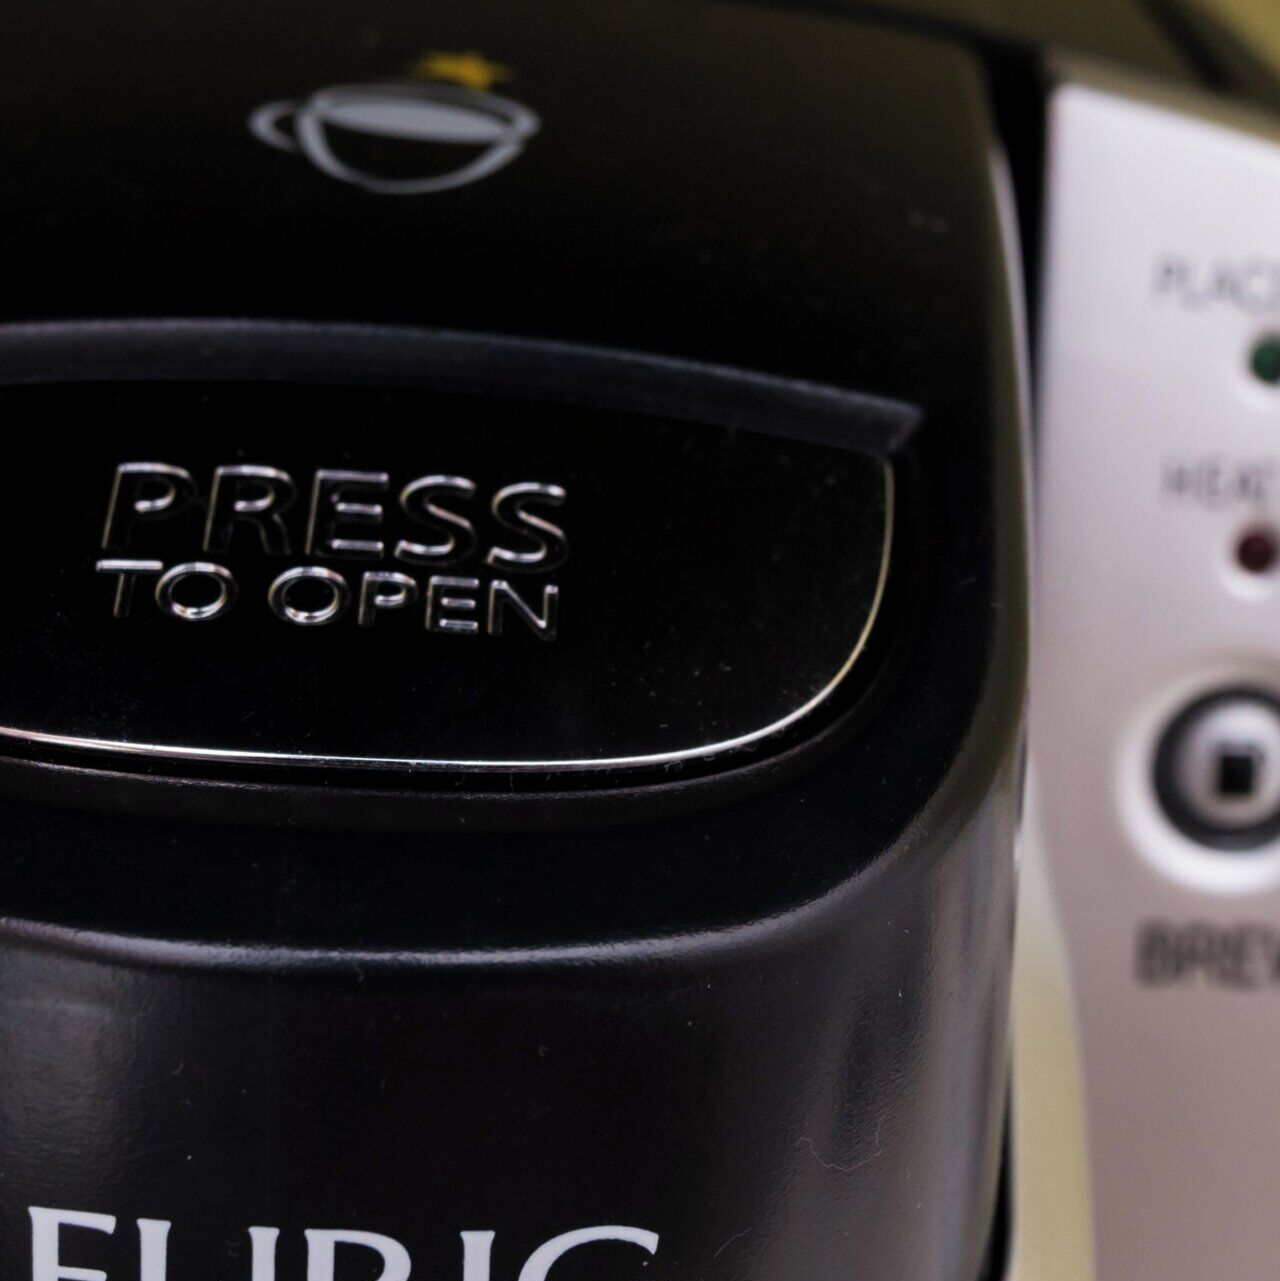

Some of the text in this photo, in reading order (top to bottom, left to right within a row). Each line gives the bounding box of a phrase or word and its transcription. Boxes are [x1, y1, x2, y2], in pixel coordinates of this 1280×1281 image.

[100, 461, 568, 573] PRESS
[96, 559, 560, 641] TO OPEN
